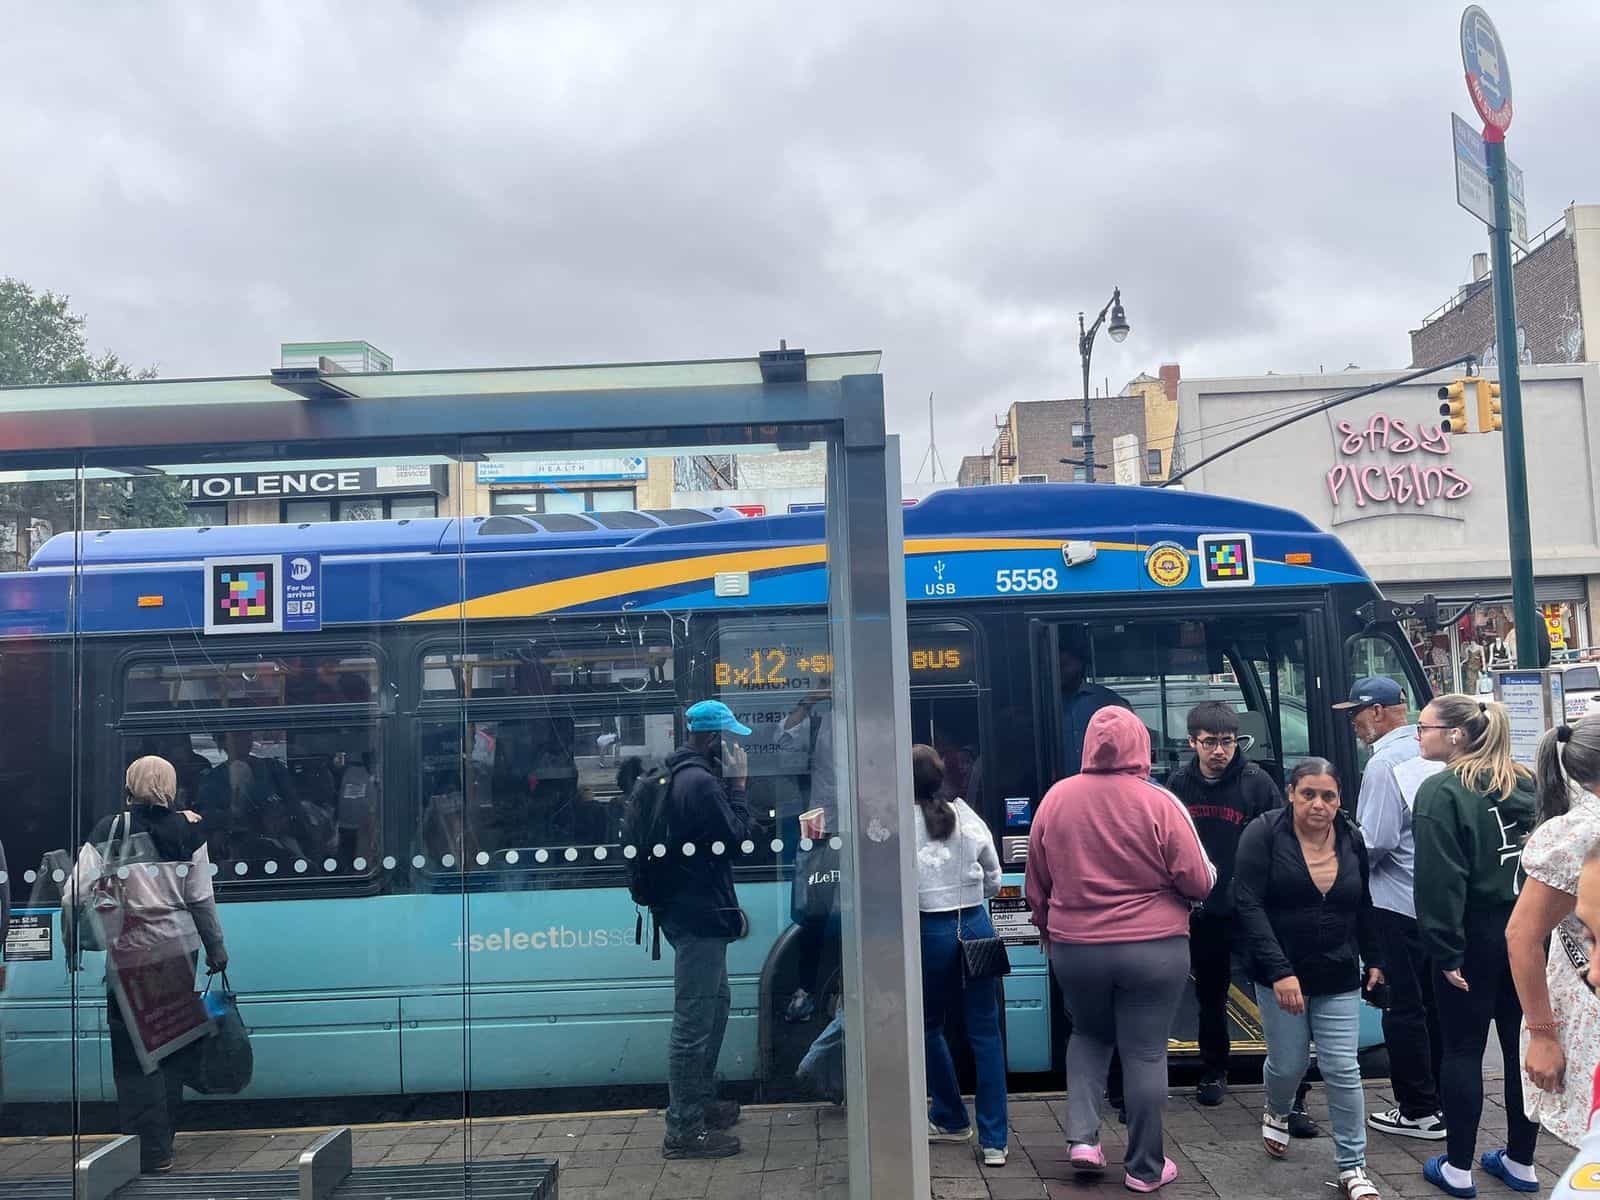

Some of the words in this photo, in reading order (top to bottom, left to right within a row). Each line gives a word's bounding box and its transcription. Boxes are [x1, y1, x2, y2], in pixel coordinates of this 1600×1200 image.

[538, 463, 586, 472] HEALTH
[995, 568, 1059, 593] 5558
[286, 584, 300, 592] For
[925, 583, 956, 595] USB
[286, 591, 315, 599] arrival
[911, 649, 961, 669] BUS
